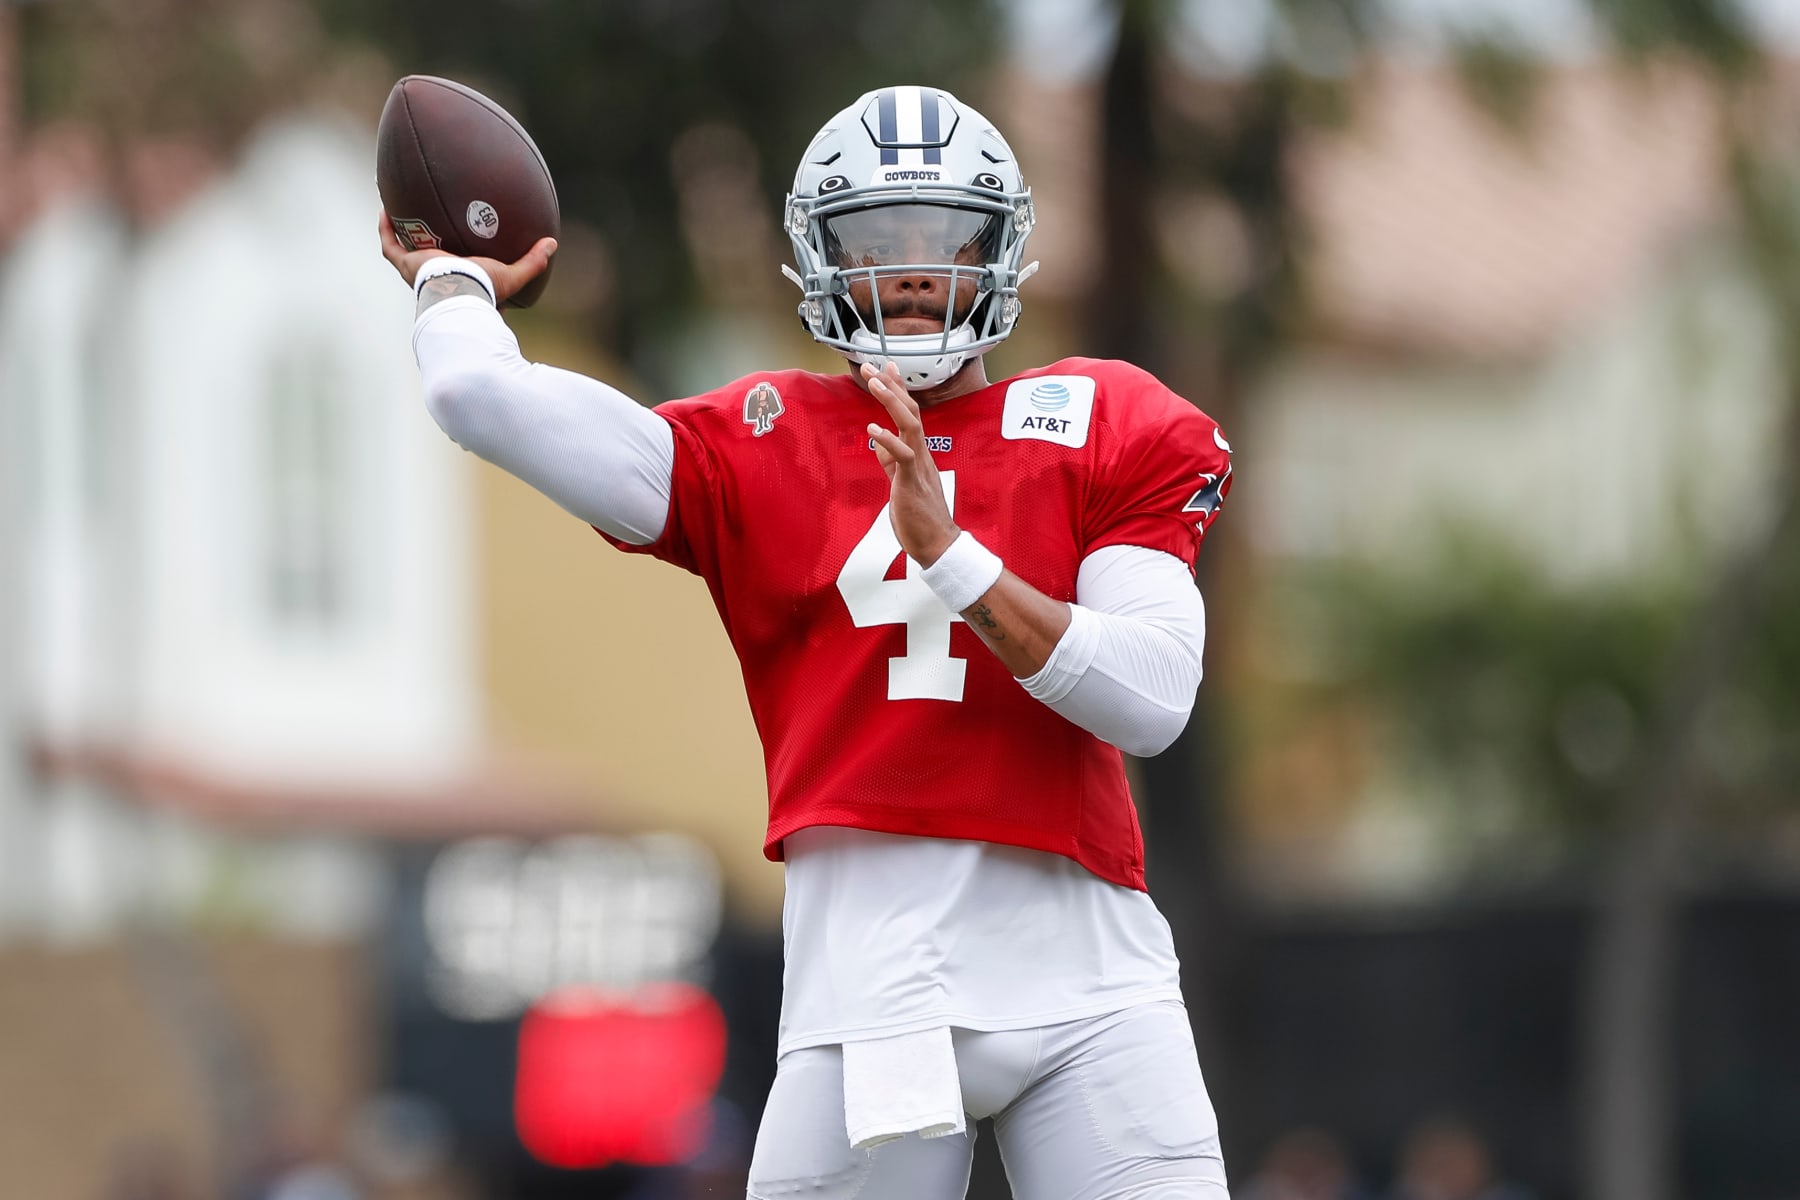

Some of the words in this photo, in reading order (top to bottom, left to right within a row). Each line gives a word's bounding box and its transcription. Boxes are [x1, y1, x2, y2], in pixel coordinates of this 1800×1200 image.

[884, 171, 940, 181] COWBOYS
[407, 224, 434, 249] FL
[1021, 416, 1072, 434] AT&T
[836, 470, 967, 702] 4
